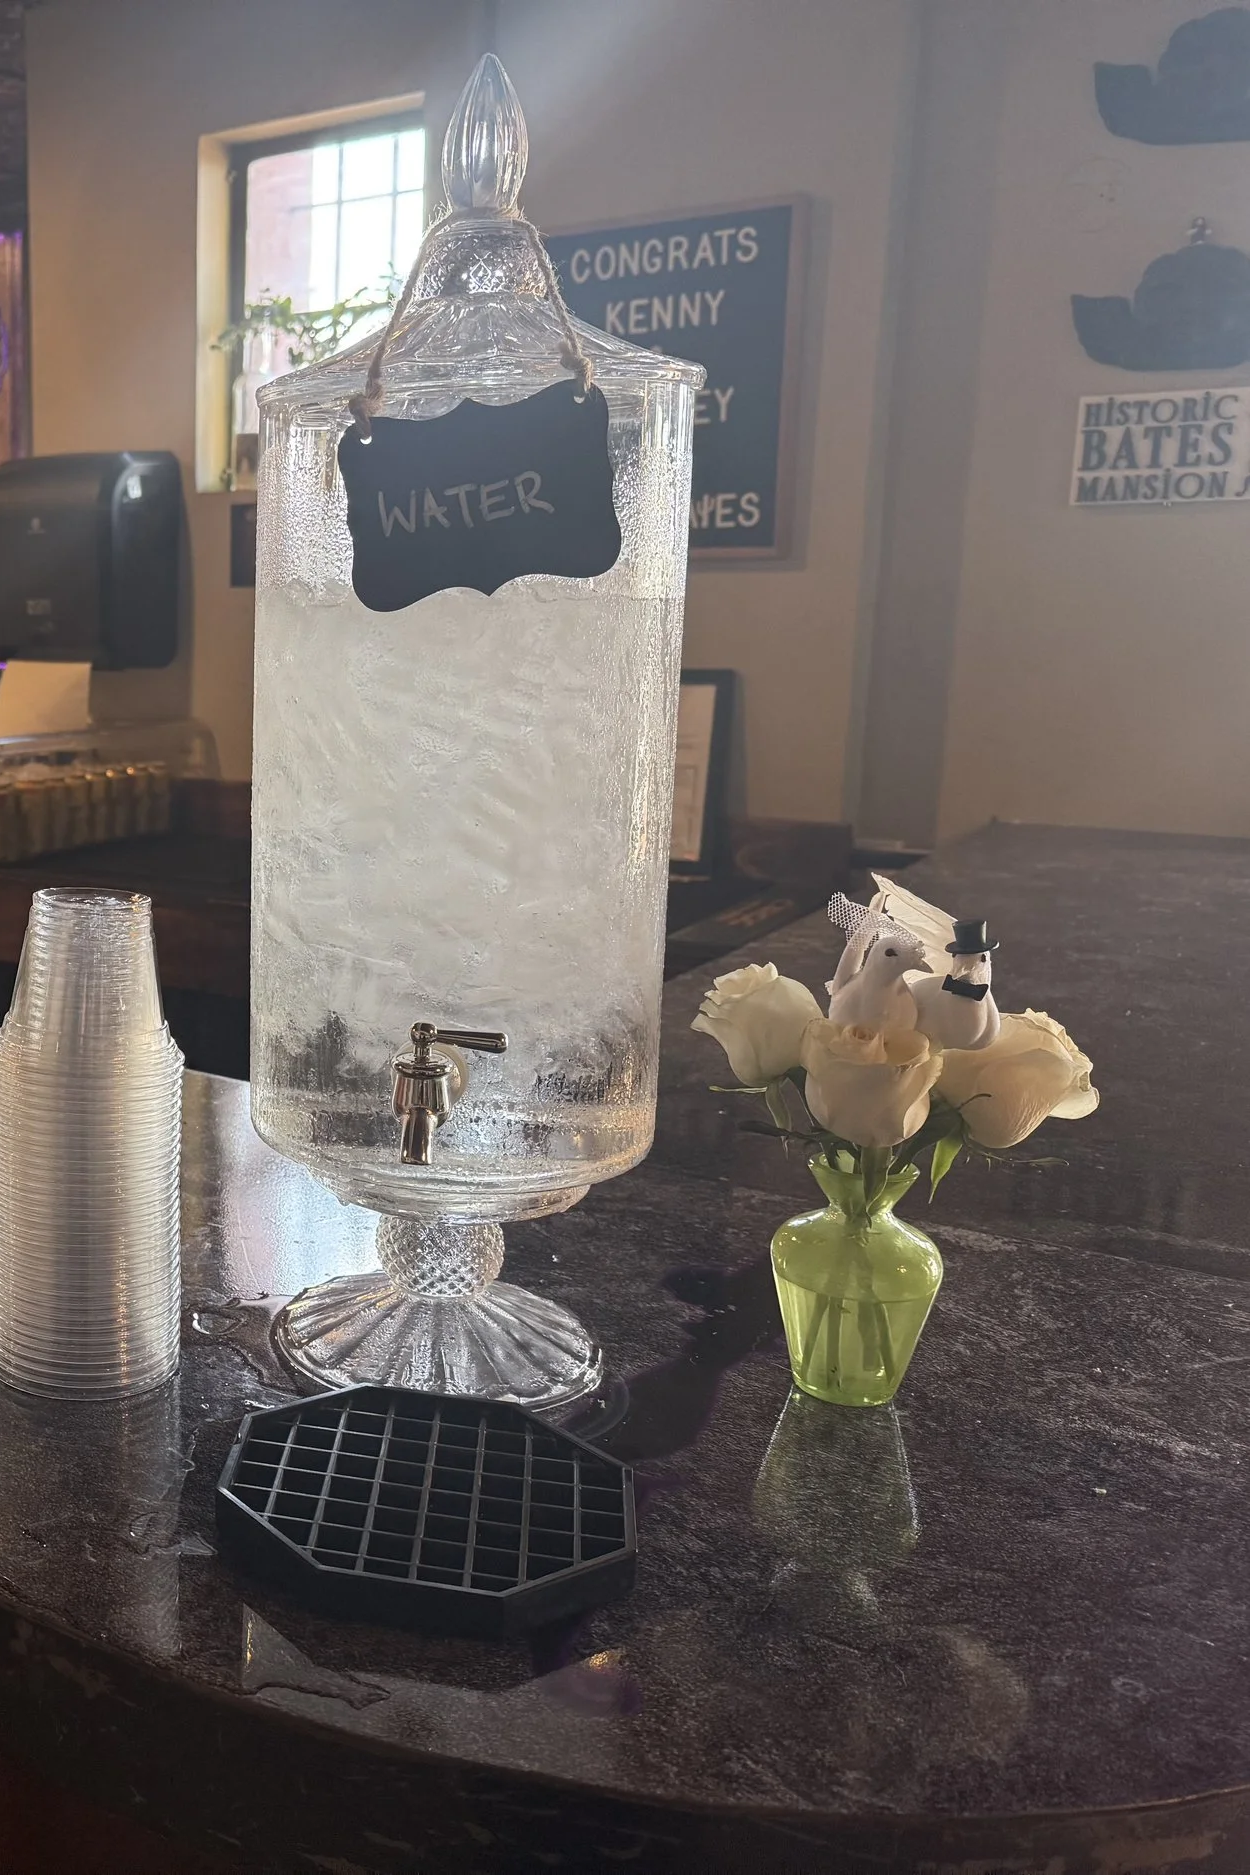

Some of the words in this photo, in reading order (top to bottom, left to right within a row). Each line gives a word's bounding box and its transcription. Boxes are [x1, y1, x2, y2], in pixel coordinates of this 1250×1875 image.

[570, 227, 759, 284] CONGRATS
[605, 290, 726, 335] KENNY
[694, 385, 735, 425] EY
[1077, 421, 1234, 471] BATES
[377, 470, 555, 537] WATER
[1074, 468, 1229, 503] MANSION
